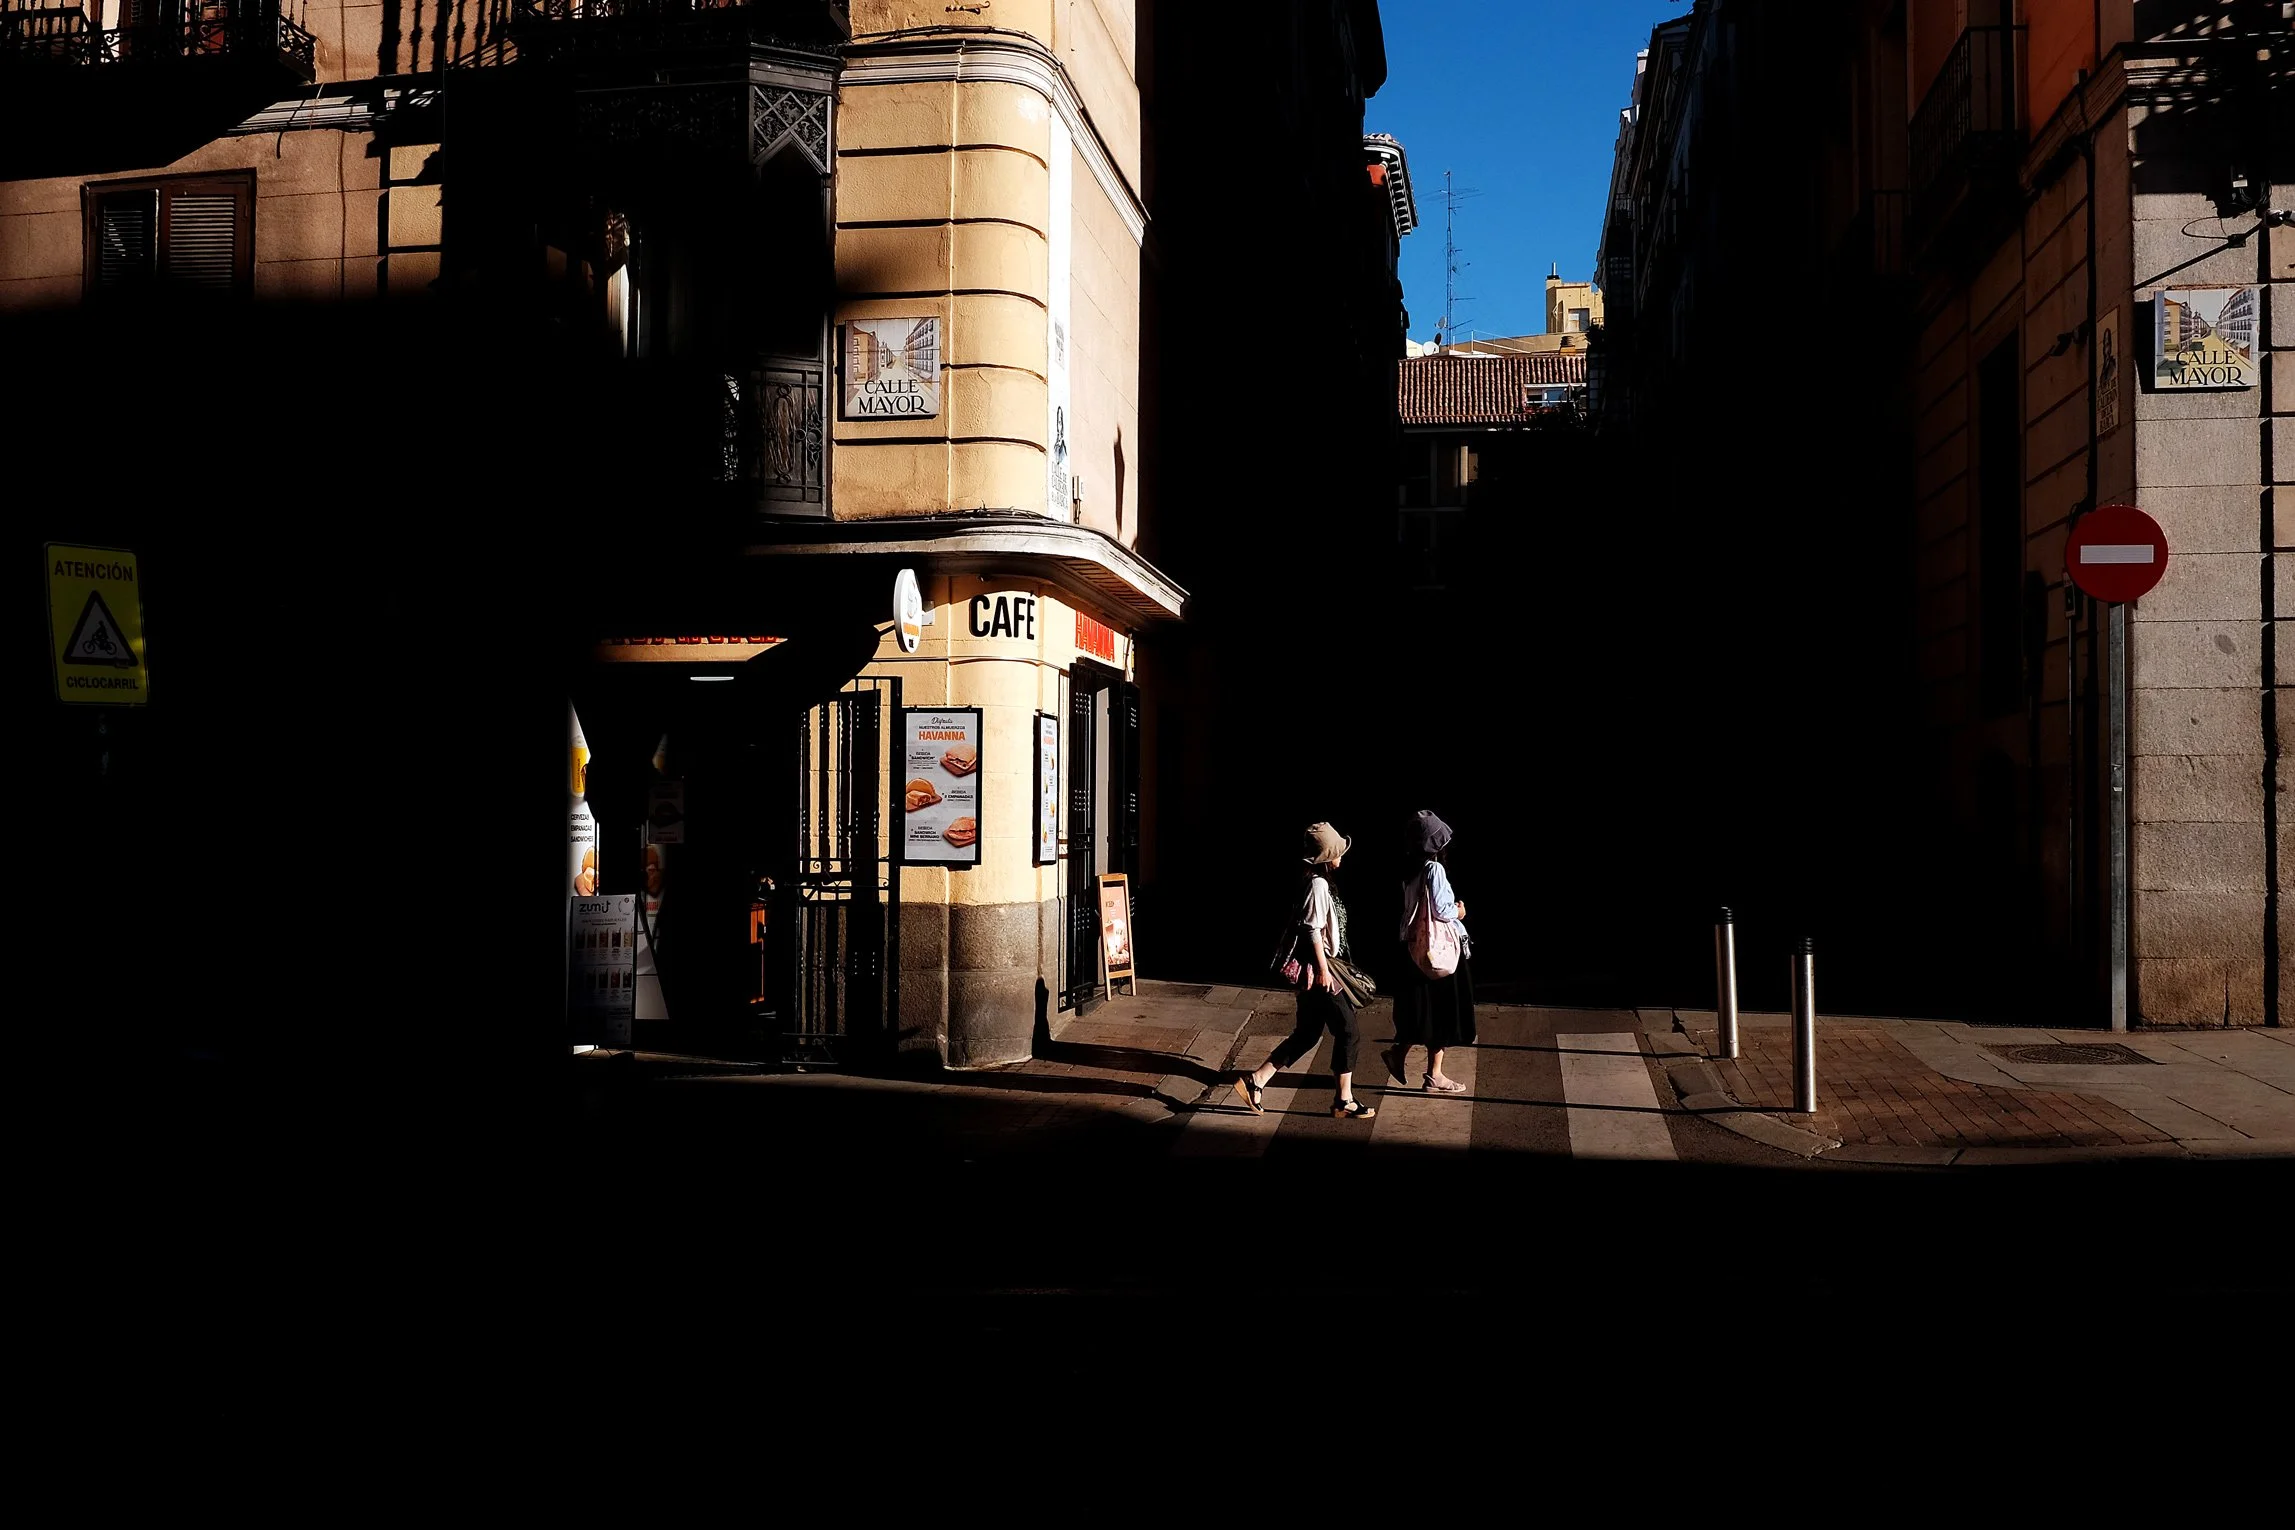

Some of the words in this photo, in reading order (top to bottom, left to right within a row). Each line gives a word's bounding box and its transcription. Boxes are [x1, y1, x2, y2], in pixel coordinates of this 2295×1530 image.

[2176, 350, 2237, 366] CALLE
[2169, 366, 2247, 386] MAYOR
[864, 379, 920, 394] CALLE
[858, 395, 930, 415] MAYOR
[54, 560, 134, 582] ATENCIÓN
[968, 590, 1036, 641] CAFÉ
[66, 676, 140, 690] CICLOCARRIL
[918, 731, 966, 741] HAVANNA
